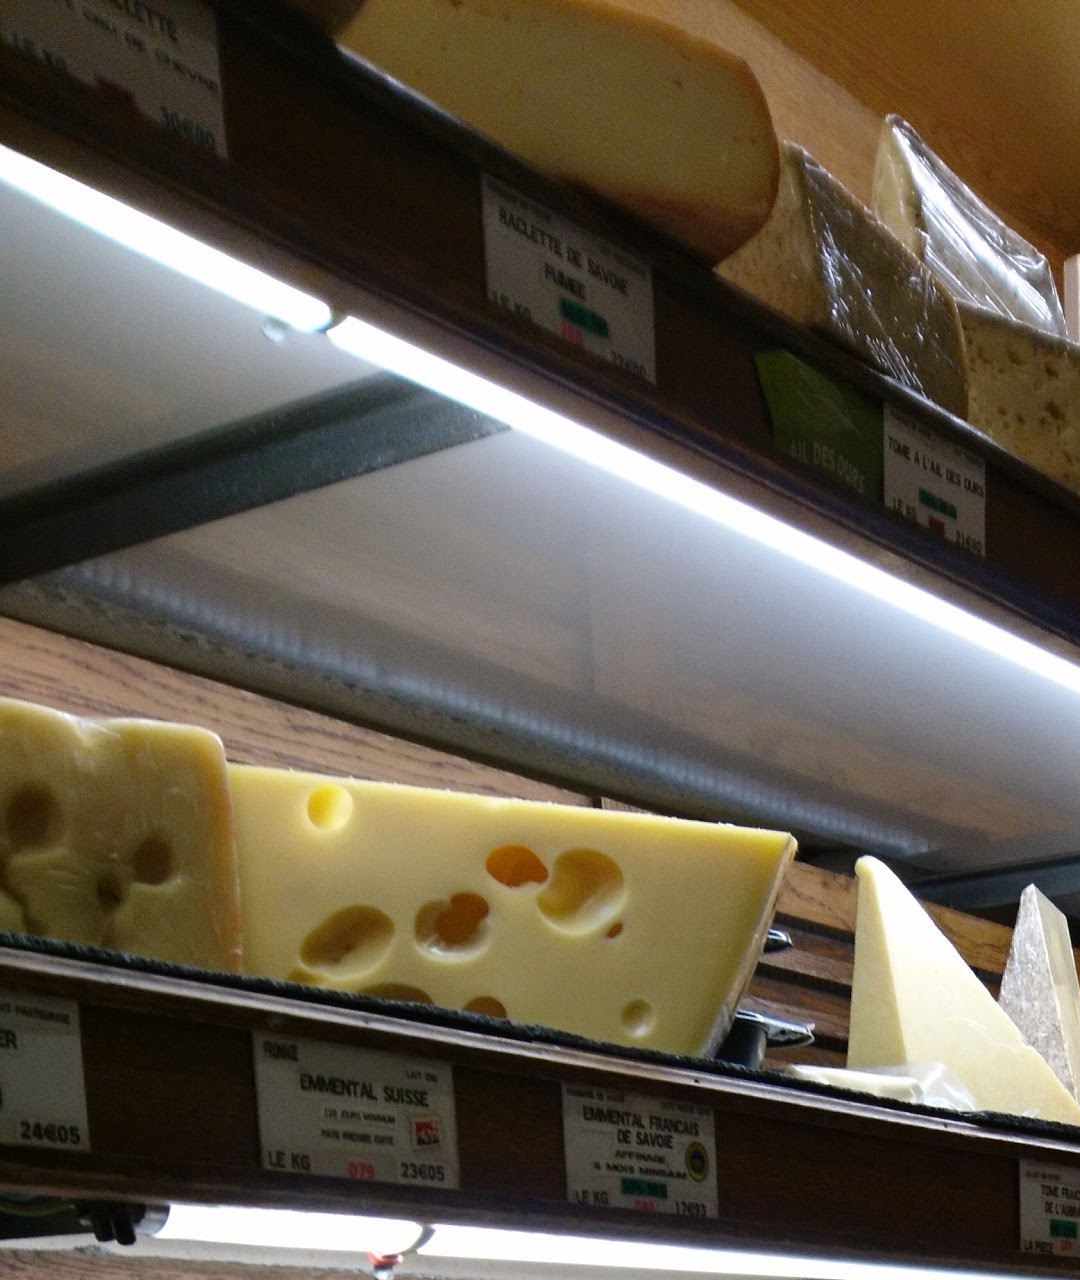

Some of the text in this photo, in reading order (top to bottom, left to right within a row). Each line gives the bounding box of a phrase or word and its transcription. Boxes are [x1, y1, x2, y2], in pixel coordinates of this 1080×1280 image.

[499, 206, 565, 260] RACLETTE
[566, 247, 583, 269] DE
[587, 258, 629, 296] SAVOIE
[888, 435, 911, 461] TOME
[945, 468, 962, 488] DES
[300, 1072, 430, 1108] EMMENTAL SUISSE
[20, 1120, 82, 1145] 24€05
[583, 1105, 646, 1130] EMMENTAL
[649, 1115, 700, 1138] FRANCAIS
[617, 1128, 674, 1150] DE SAVOIE
[268, 1150, 287, 1169] LE
[291, 1153, 312, 1172] KG
[400, 1161, 445, 1183] 23€05
[1040, 1183, 1059, 1199] TOME
